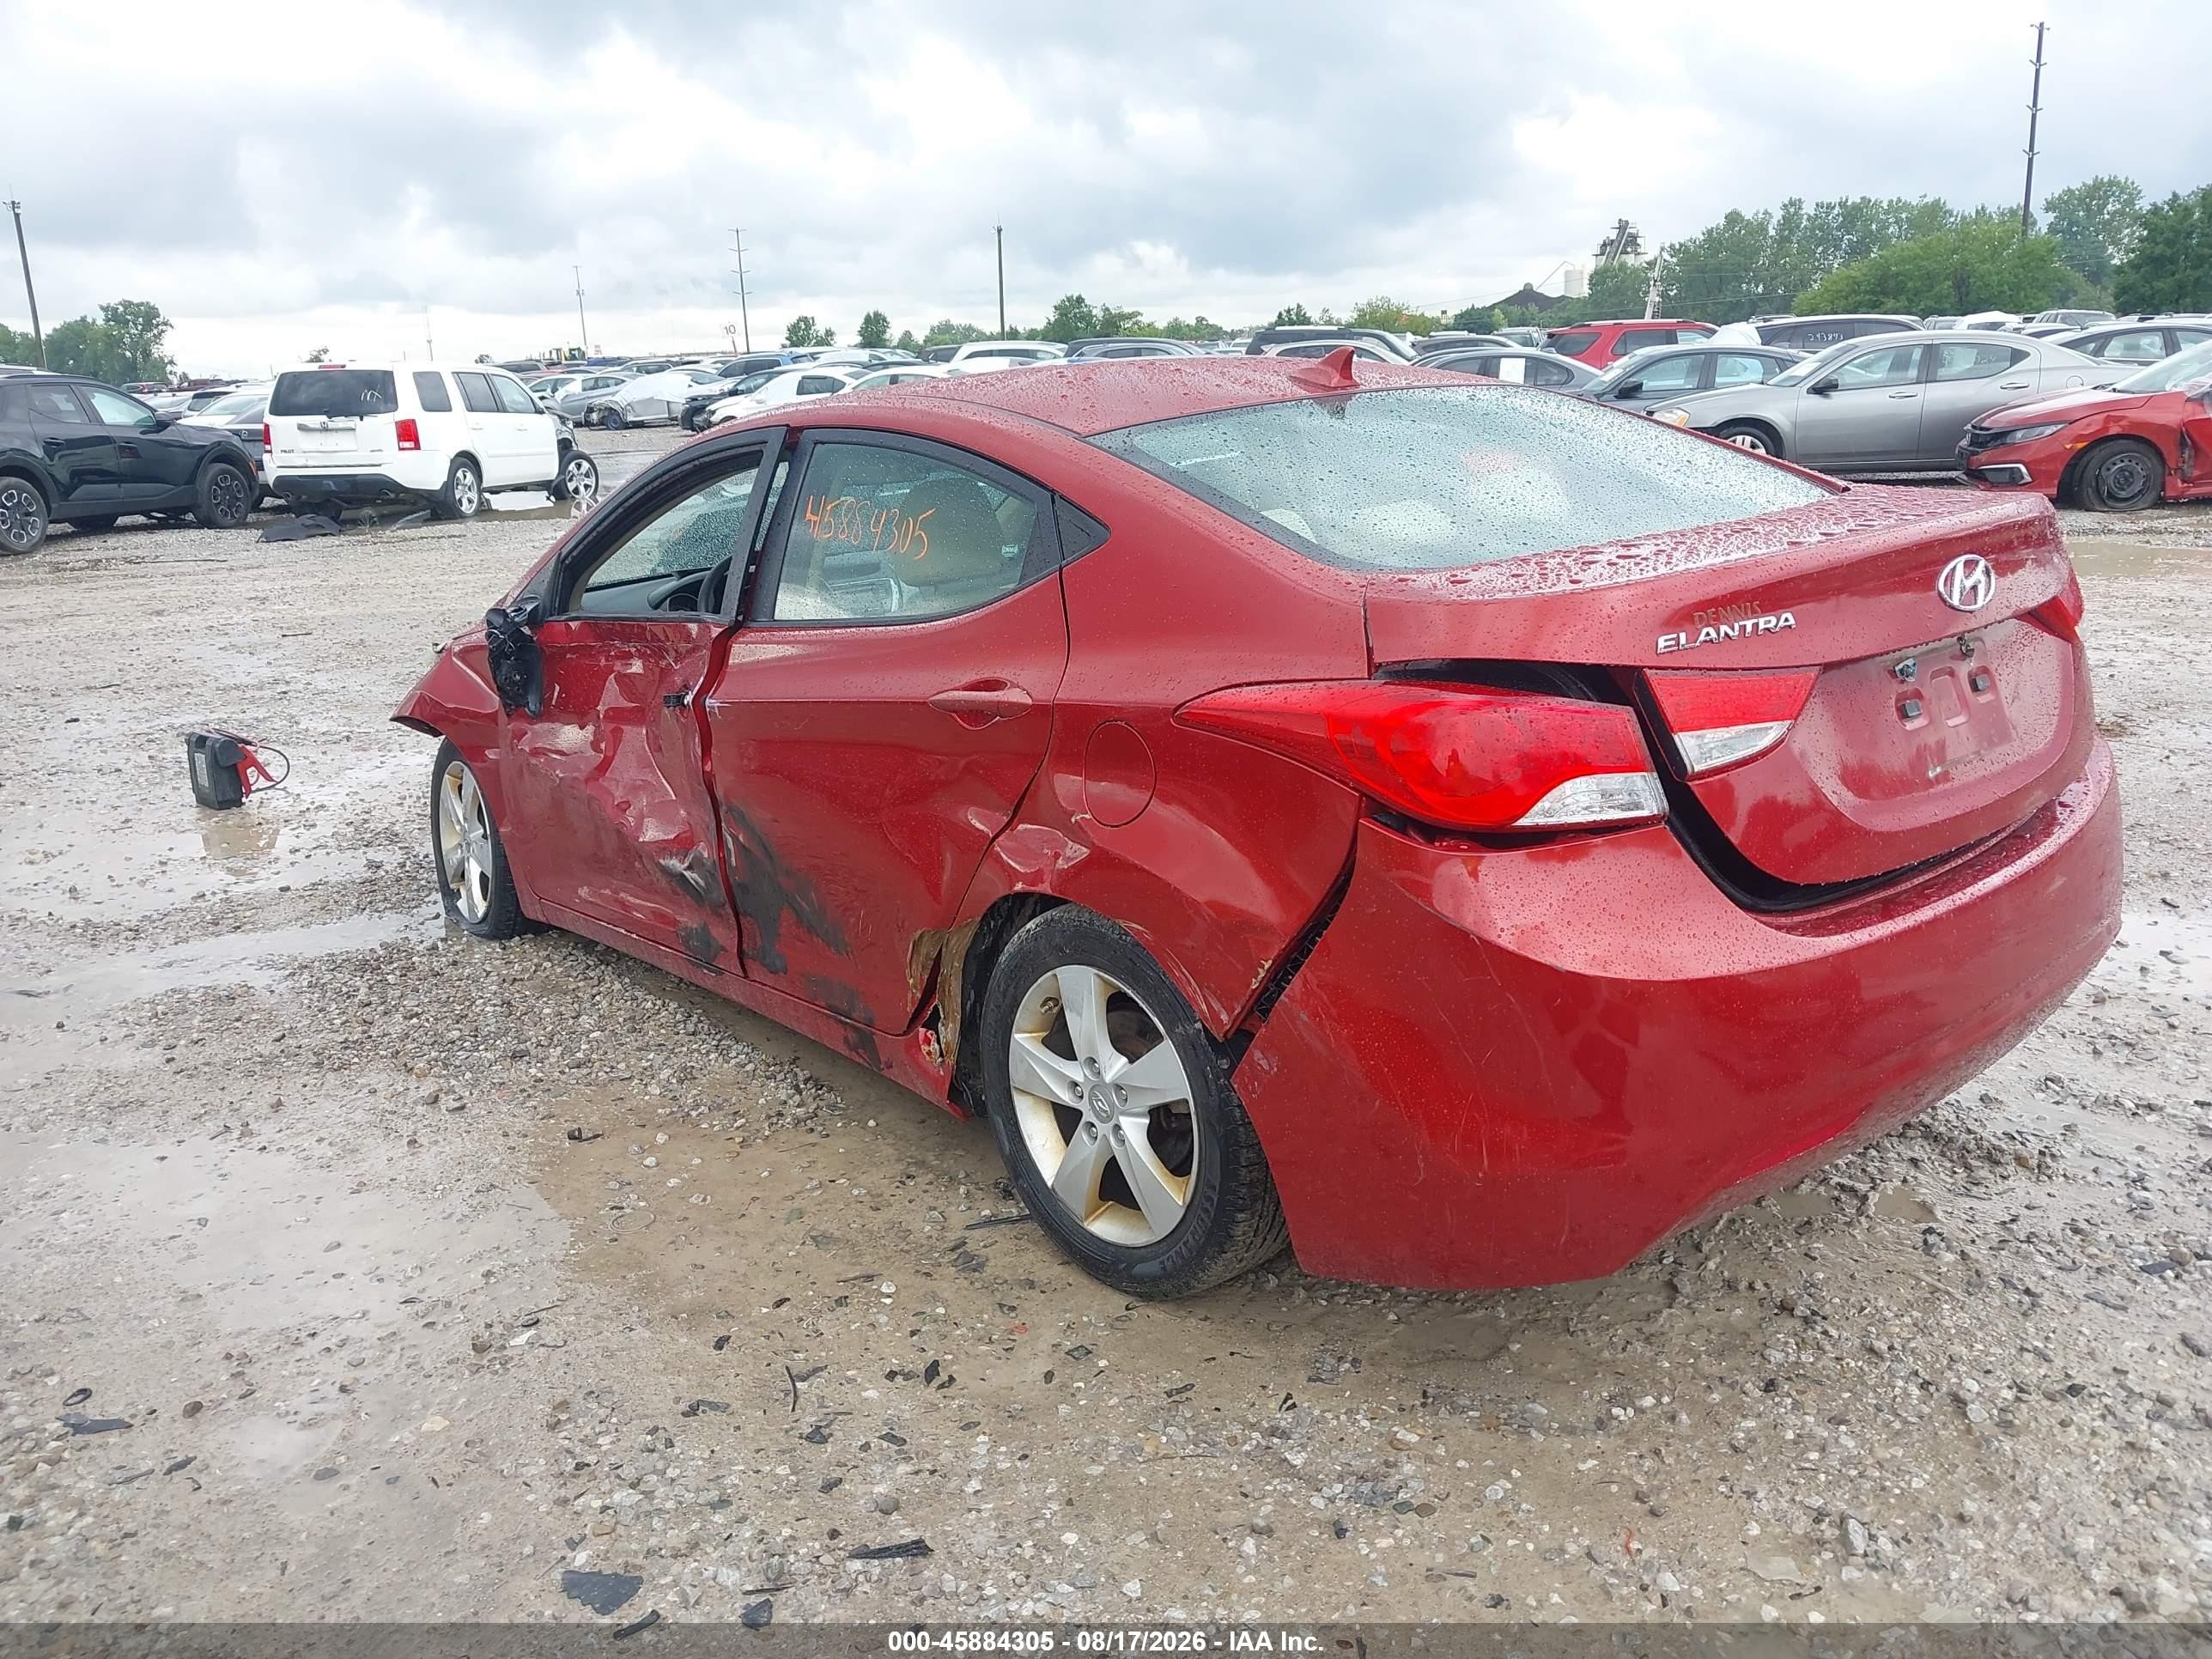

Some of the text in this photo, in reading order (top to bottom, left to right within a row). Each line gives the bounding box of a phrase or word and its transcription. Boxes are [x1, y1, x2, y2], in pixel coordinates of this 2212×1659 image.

[724, 324, 737, 335] 10
[805, 495, 936, 562] 45884305
[1656, 611, 1797, 655] ELANTRA
[1692, 601, 1763, 629] DENNIS
